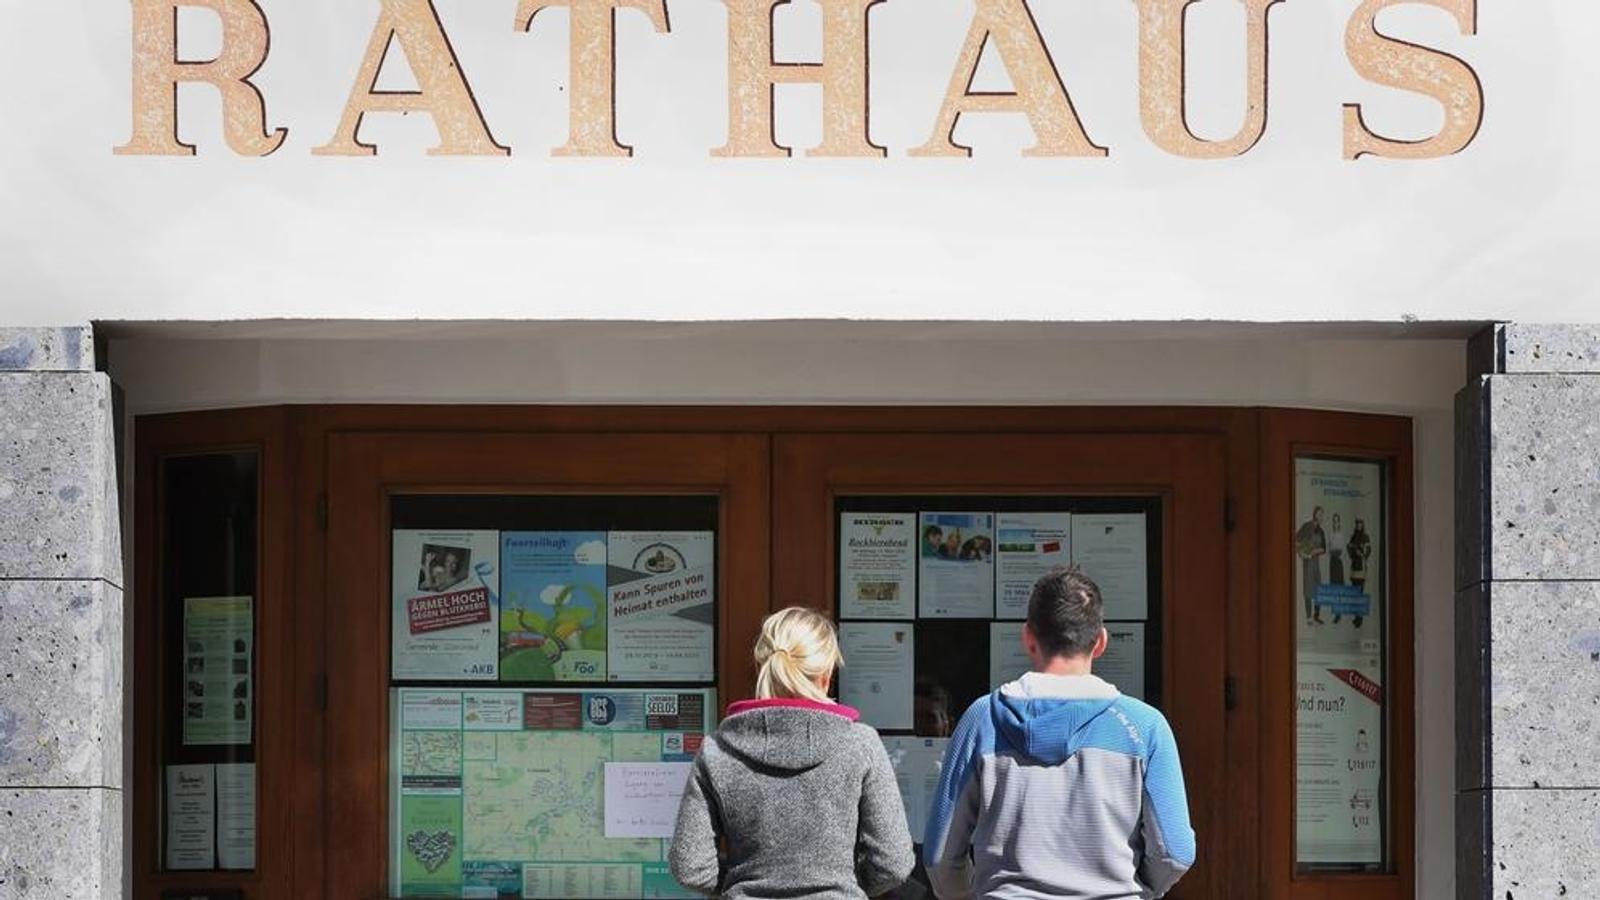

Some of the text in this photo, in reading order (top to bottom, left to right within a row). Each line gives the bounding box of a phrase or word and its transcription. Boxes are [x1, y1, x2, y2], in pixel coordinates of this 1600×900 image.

[113, 0, 1485, 159] RATHAUS
[451, 591, 485, 606] HOCH
[614, 573, 705, 603] Kann Spuren von
[614, 588, 707, 616] Heimat enthalten
[471, 664, 494, 674] AKB
[1317, 696, 1346, 711] nun?
